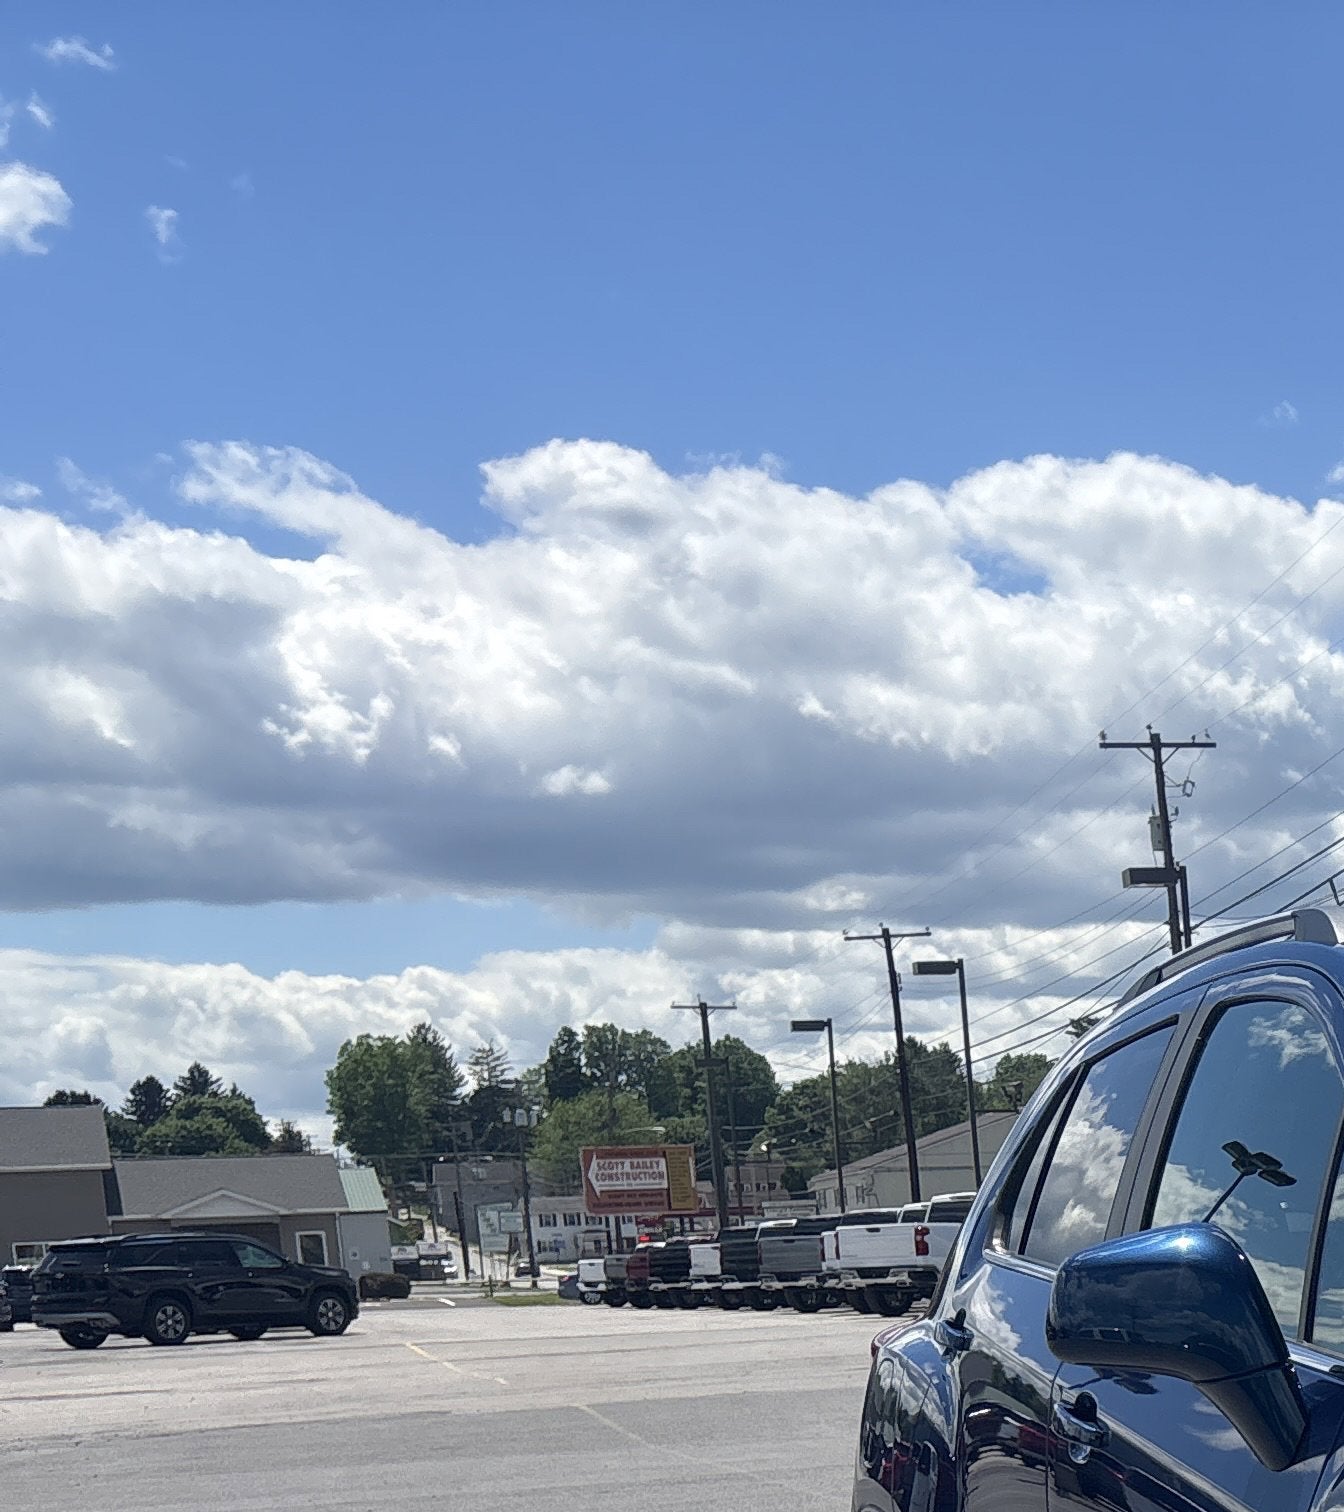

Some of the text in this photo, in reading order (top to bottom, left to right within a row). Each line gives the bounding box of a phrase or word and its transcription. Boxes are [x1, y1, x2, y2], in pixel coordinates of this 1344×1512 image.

[596, 1160, 660, 1172] SCOTT BAILEY
[595, 1171, 664, 1182] CONSTRUCTION
